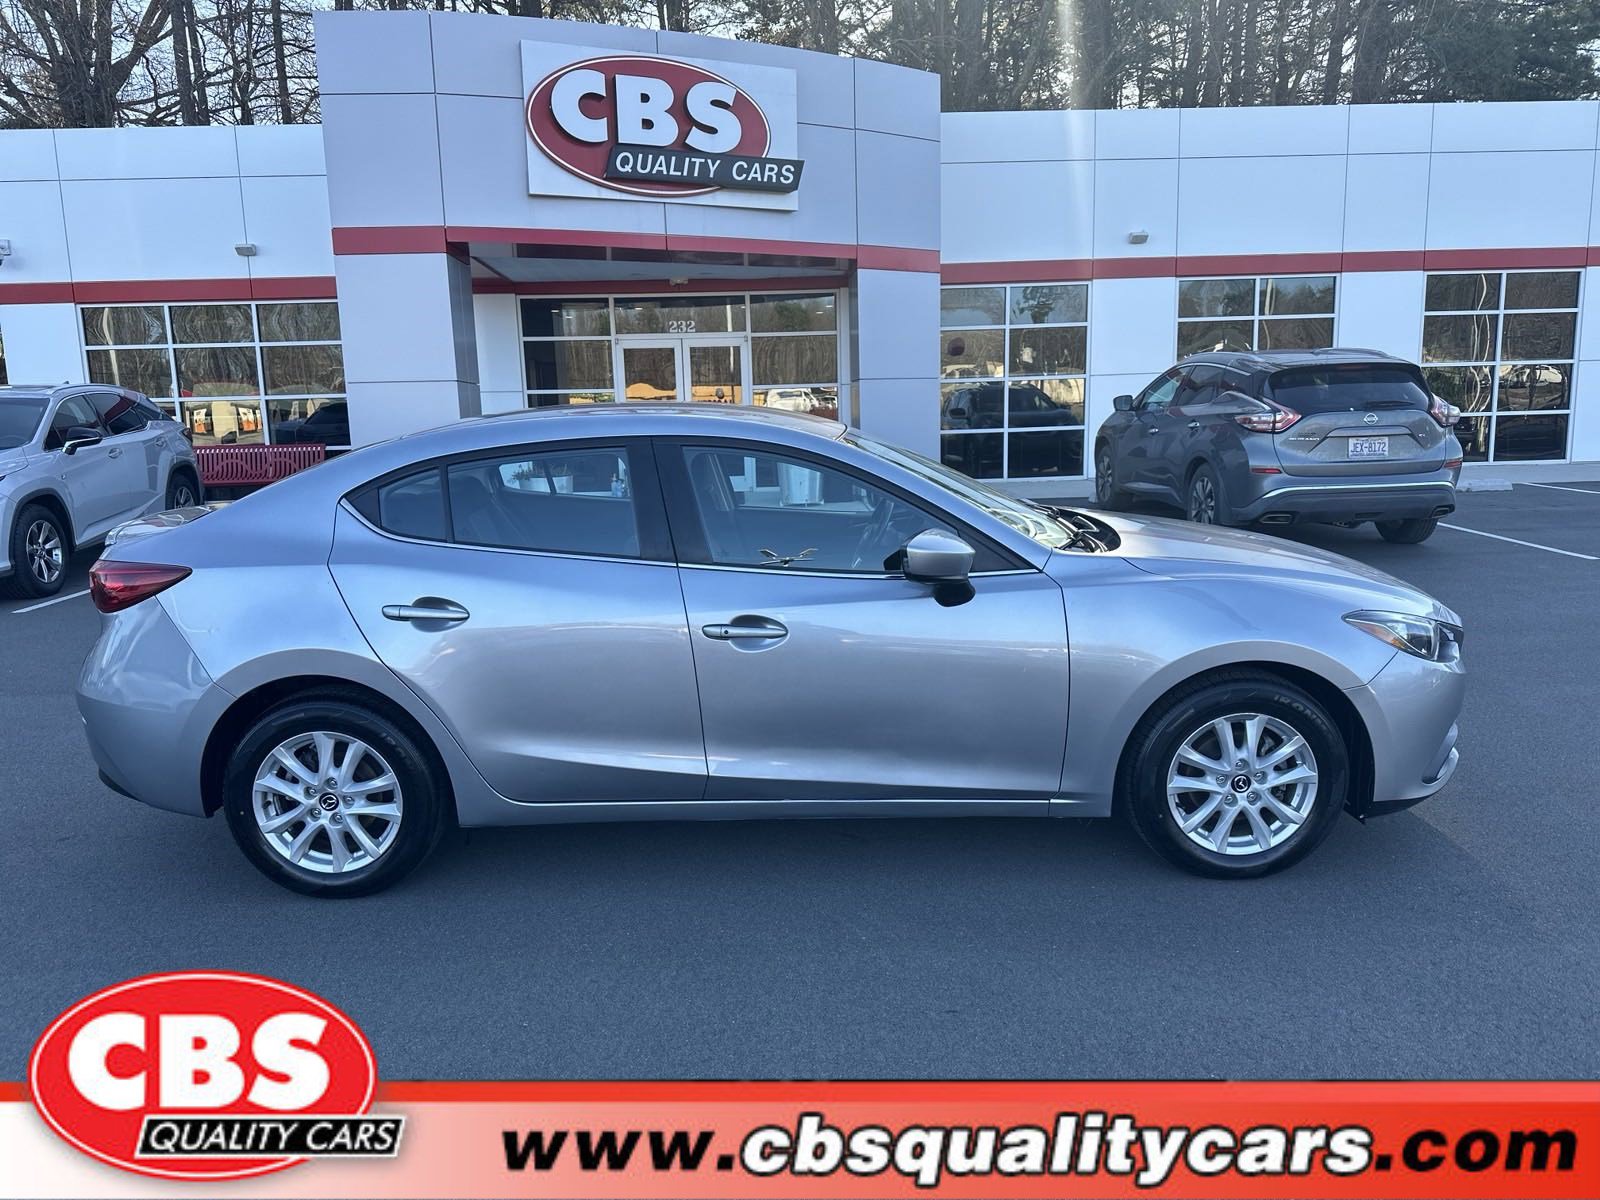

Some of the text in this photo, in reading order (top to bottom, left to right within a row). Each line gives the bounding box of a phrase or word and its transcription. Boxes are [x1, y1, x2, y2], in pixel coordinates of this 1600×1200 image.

[550, 68, 743, 154] CBS
[615, 151, 795, 185] QUALITY CARS
[668, 320, 696, 333] 232
[1350, 441, 1388, 453] JEX-8172
